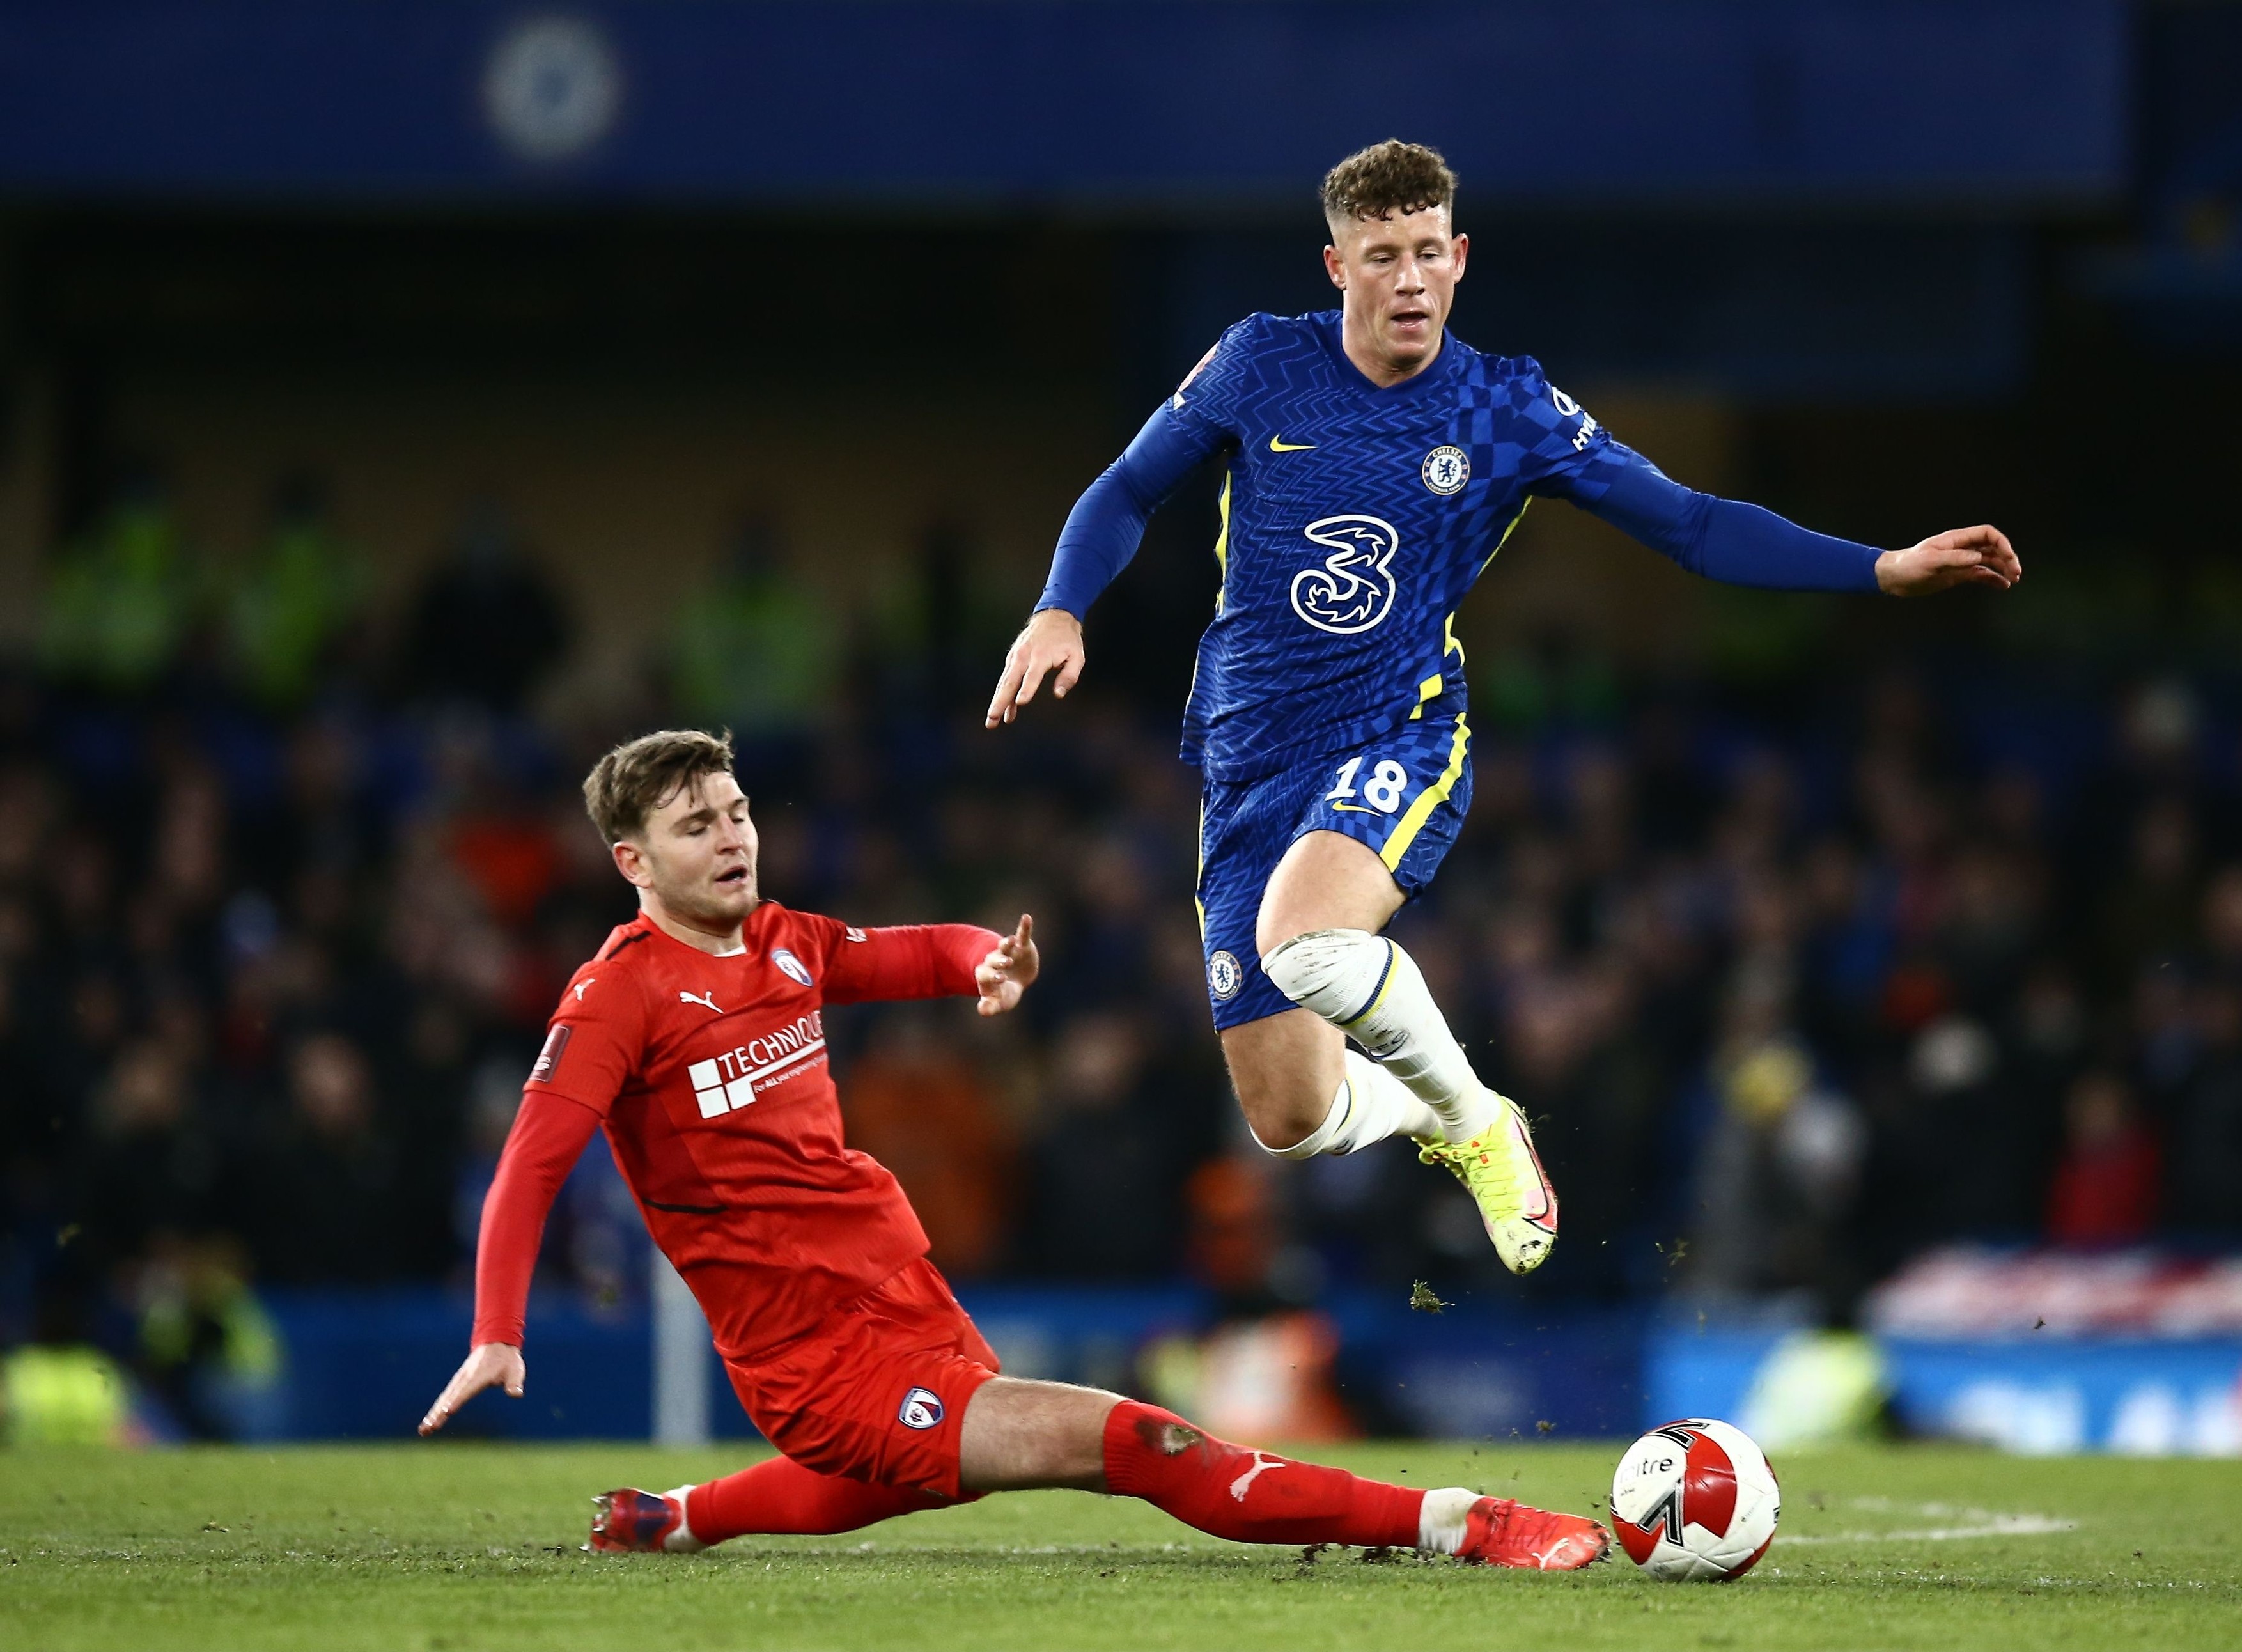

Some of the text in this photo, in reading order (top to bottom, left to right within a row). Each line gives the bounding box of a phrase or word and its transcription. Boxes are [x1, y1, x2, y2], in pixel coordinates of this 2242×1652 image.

[1432, 448, 1463, 460] CHELSEA
[1290, 514, 1399, 634] 3
[1324, 756, 1408, 813] 18
